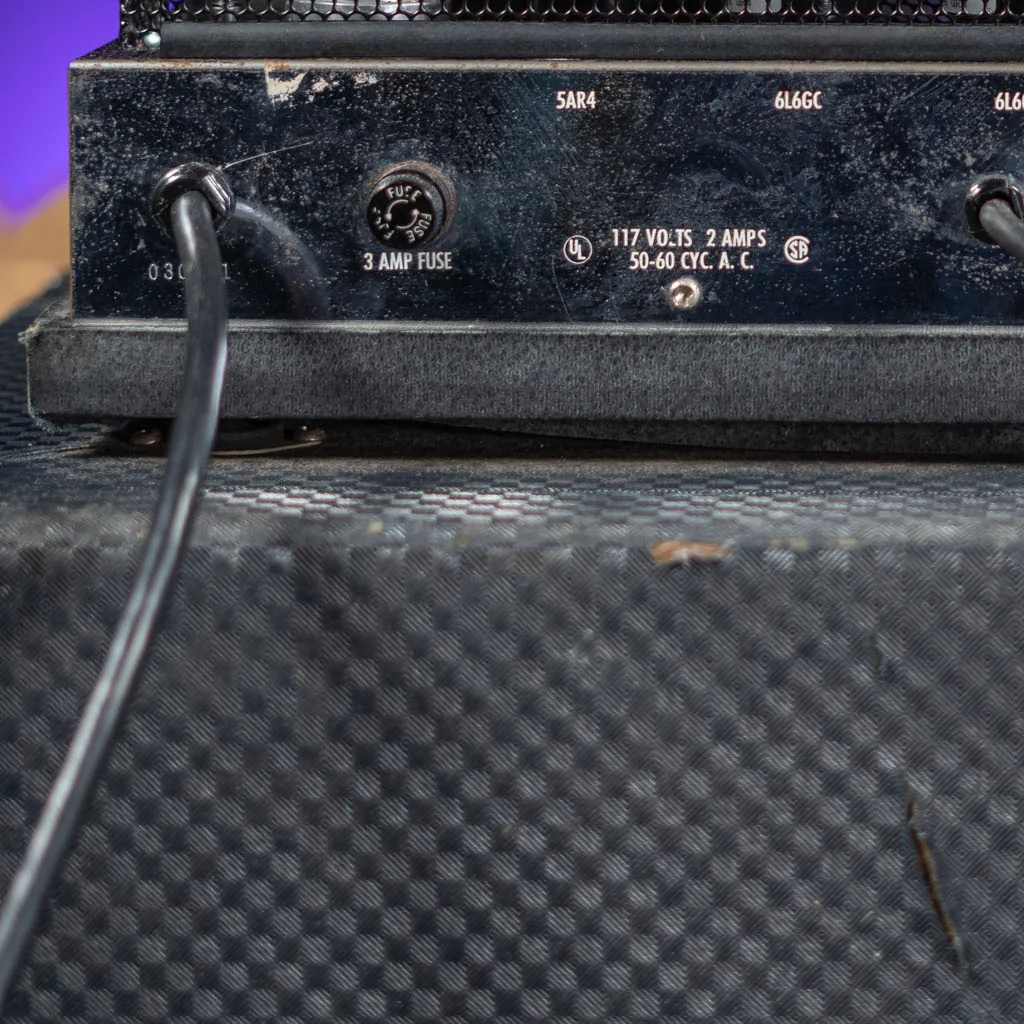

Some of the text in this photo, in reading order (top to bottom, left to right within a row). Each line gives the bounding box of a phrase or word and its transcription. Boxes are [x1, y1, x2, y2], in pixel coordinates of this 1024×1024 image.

[556, 90, 596, 110] 5AR4
[774, 90, 823, 110] 6L6GC
[386, 185, 422, 202] FUSE
[405, 213, 432, 244] FUSE
[612, 228, 767, 247] 117 VOLTS 2 AMPS
[364, 251, 452, 270] 3 AMP FUSE
[629, 251, 675, 270] 50-60
[680, 251, 714, 270] CYC.
